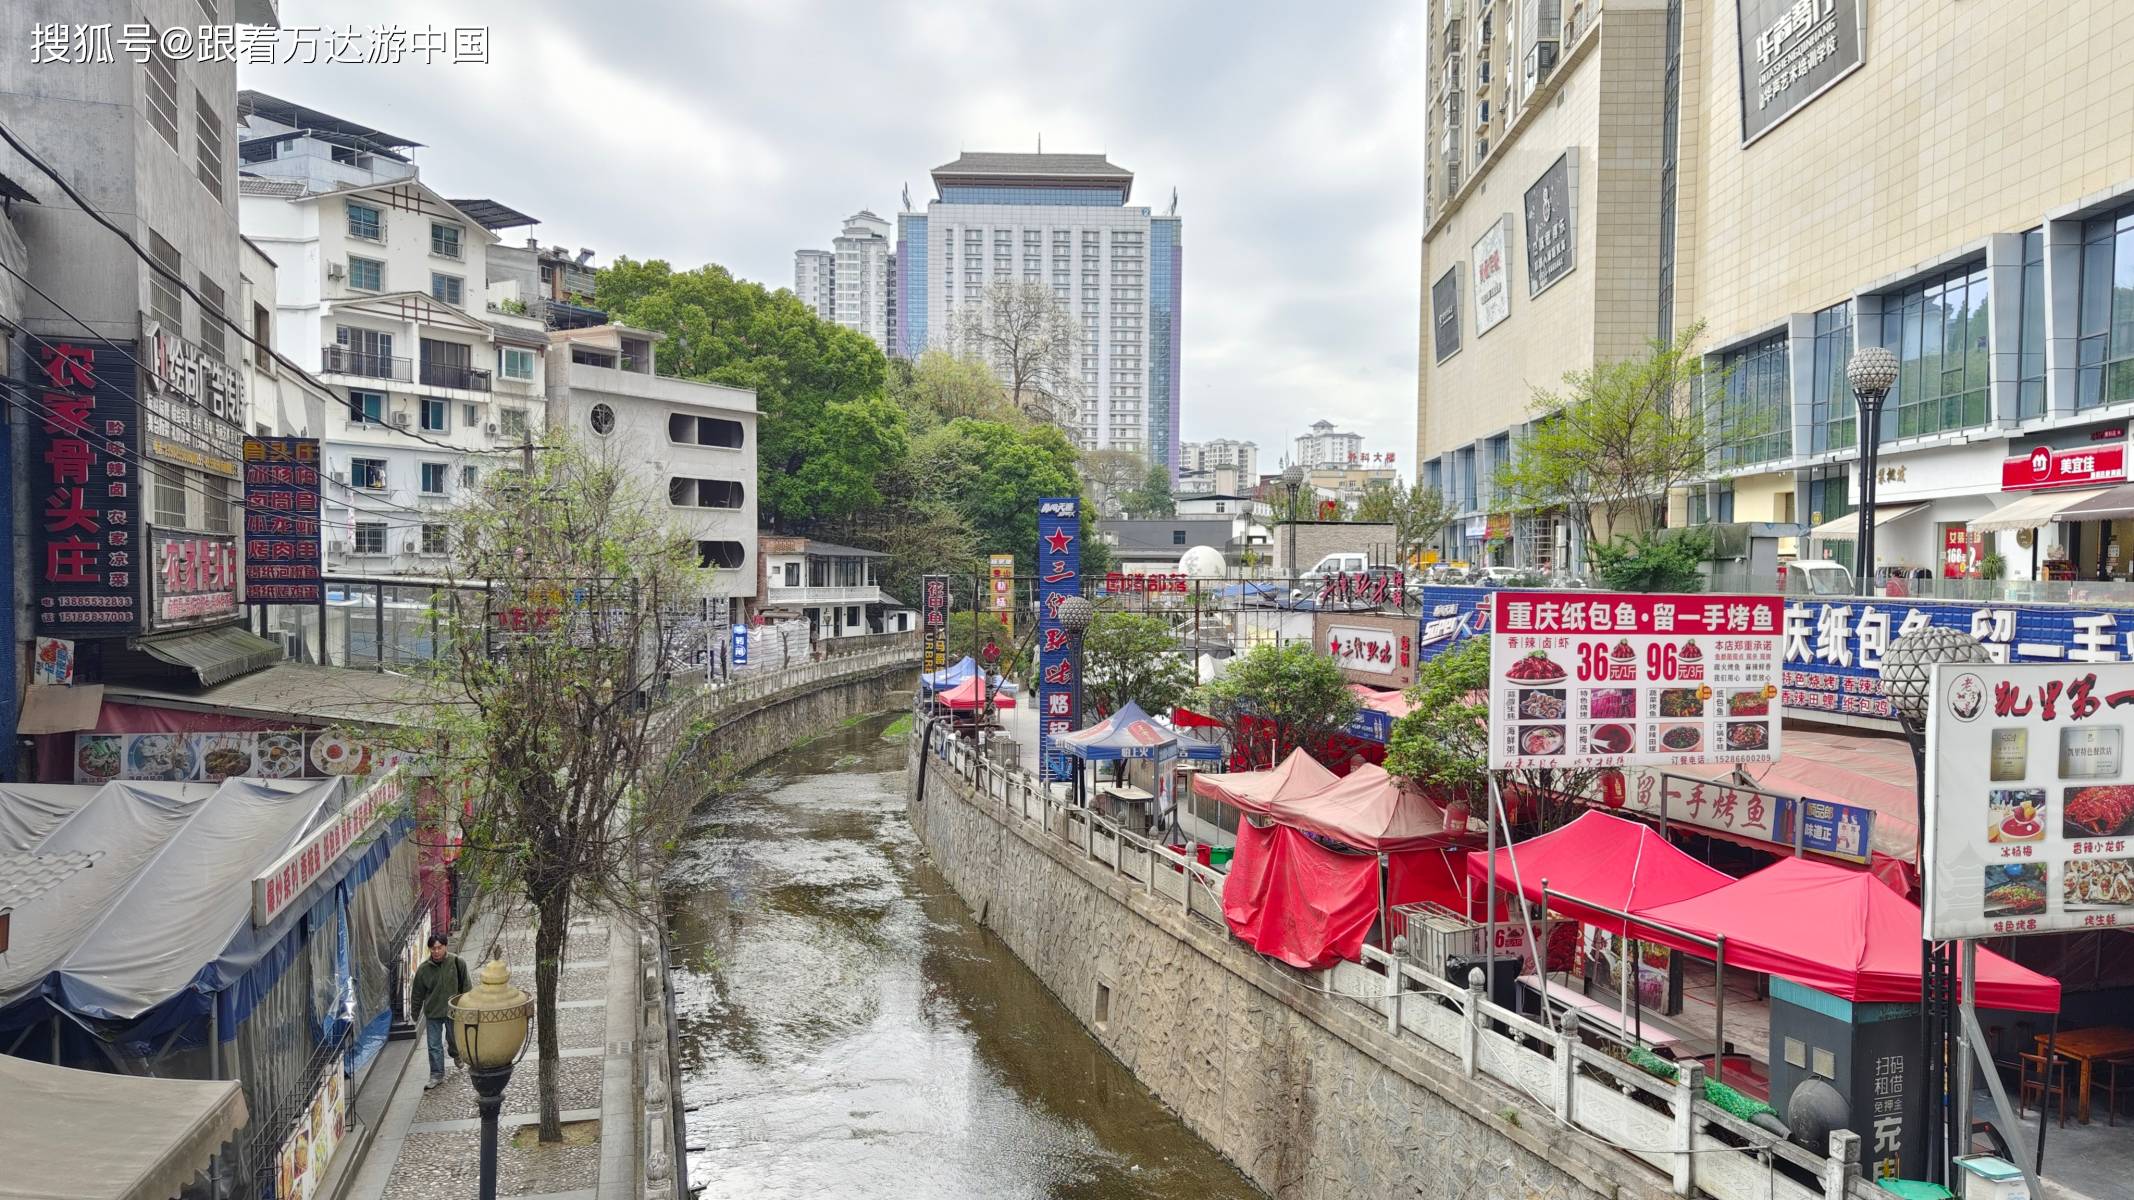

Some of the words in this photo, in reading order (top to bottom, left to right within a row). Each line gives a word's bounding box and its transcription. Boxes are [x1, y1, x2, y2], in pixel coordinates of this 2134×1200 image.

[243, 440, 316, 463] 骨头庄
[41, 343, 101, 583] 农家骨头庄
[2060, 455, 2095, 475] 美宜佳
[247, 464, 317, 487] 冰杨梅
[247, 514, 318, 537] 小龙虾
[247, 540, 318, 560] 烤肉串
[1106, 572, 1189, 592] 图腾部落
[1507, 601, 1774, 632] 重庆纸包鱼·留一手烤鱼
[1714, 640, 1772, 651] 本店郑重承诺
[1576, 642, 1609, 682] 36
[1646, 642, 1678, 682] 96
[1713, 674, 1740, 682] 我们用心
[1782, 670, 1838, 691] 特色烧烤
[1716, 690, 1725, 716] 纸包鱼
[1782, 690, 1836, 710] 香辣田螺
[1843, 694, 1889, 717] 纸包鸡
[1506, 727, 1516, 754] 海鲜粥
[1715, 753, 1772, 764] 15286600209
[1636, 771, 1768, 834] 留一手烤鱼
[1804, 822, 1833, 842] 味道正
[2000, 846, 2033, 858] 冰杨梅
[2073, 840, 2126, 855] 香辣小龙虾
[1993, 919, 2037, 933] 特色烤串
[2084, 913, 2117, 927] 烤生蚝
[1875, 1056, 1904, 1076] 扫码
[1874, 1074, 1903, 1096] 租借
[1874, 1099, 1903, 1113] 免押金
